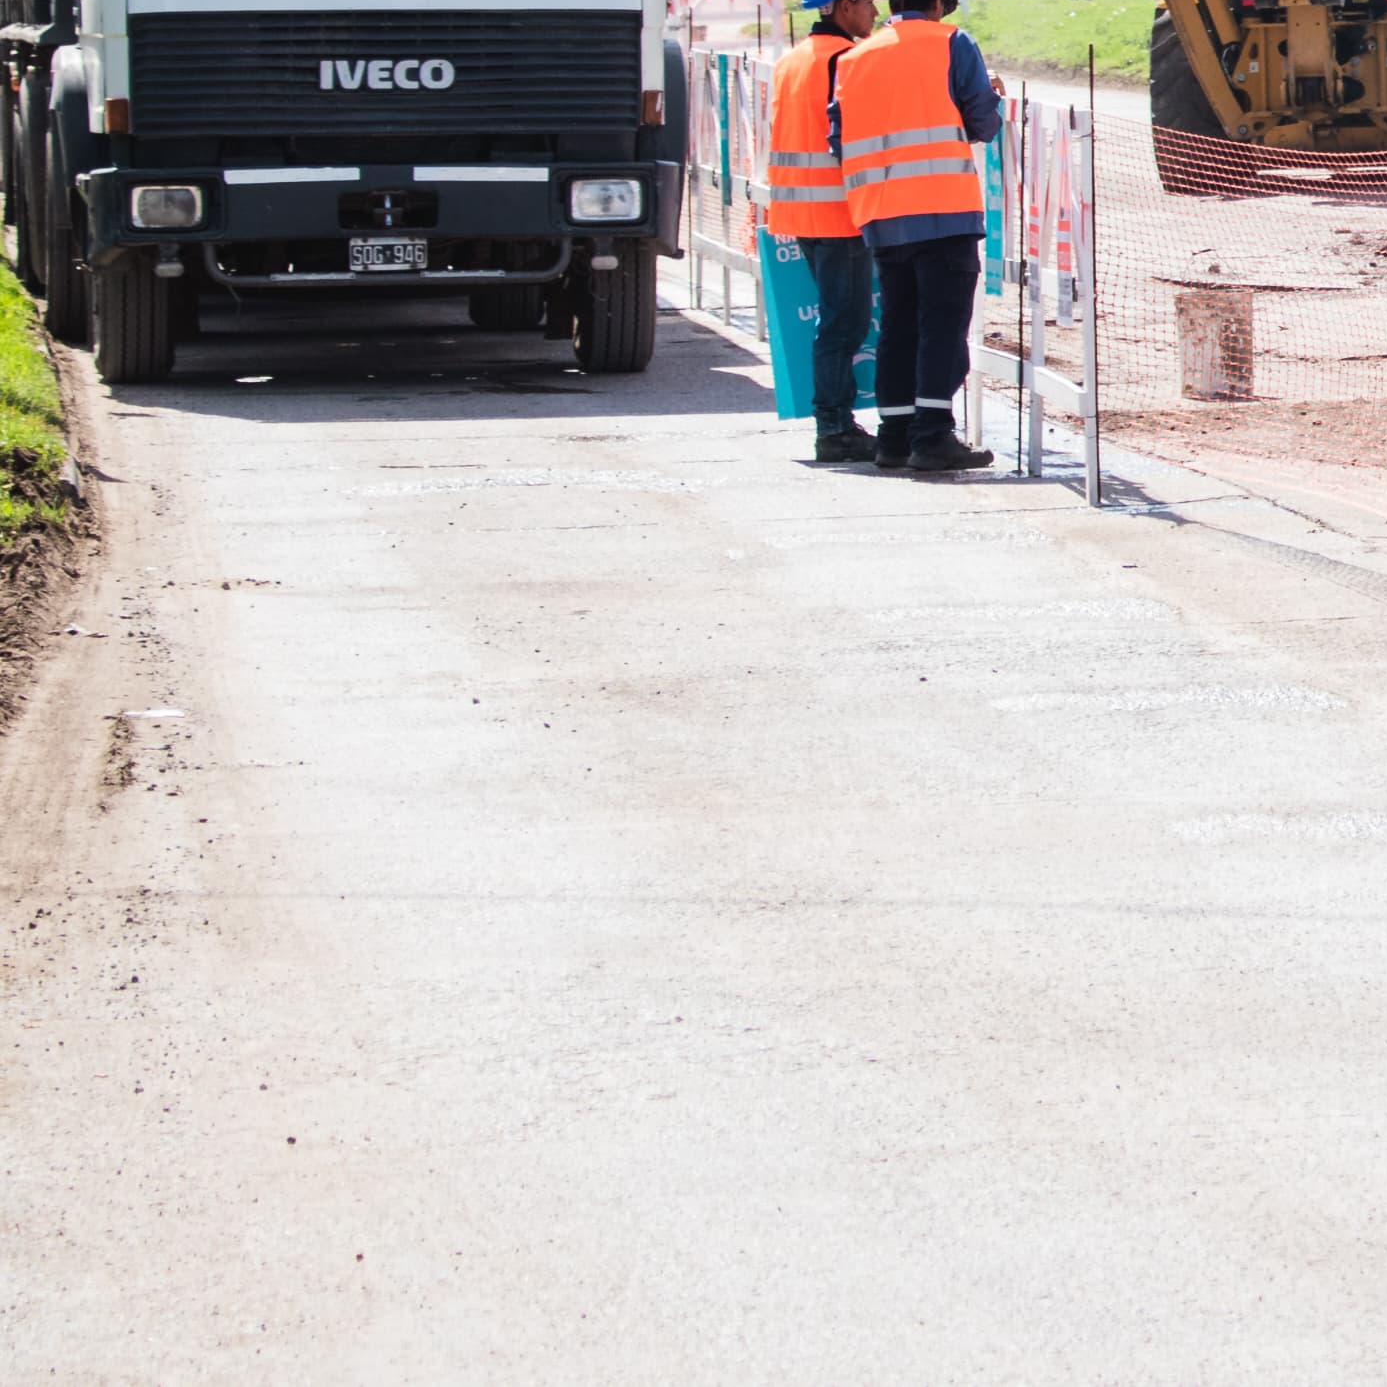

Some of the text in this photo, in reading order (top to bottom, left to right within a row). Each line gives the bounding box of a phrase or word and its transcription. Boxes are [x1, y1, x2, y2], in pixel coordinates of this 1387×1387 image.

[319, 59, 455, 90] IVECO
[352, 245, 424, 264] SOG 946
